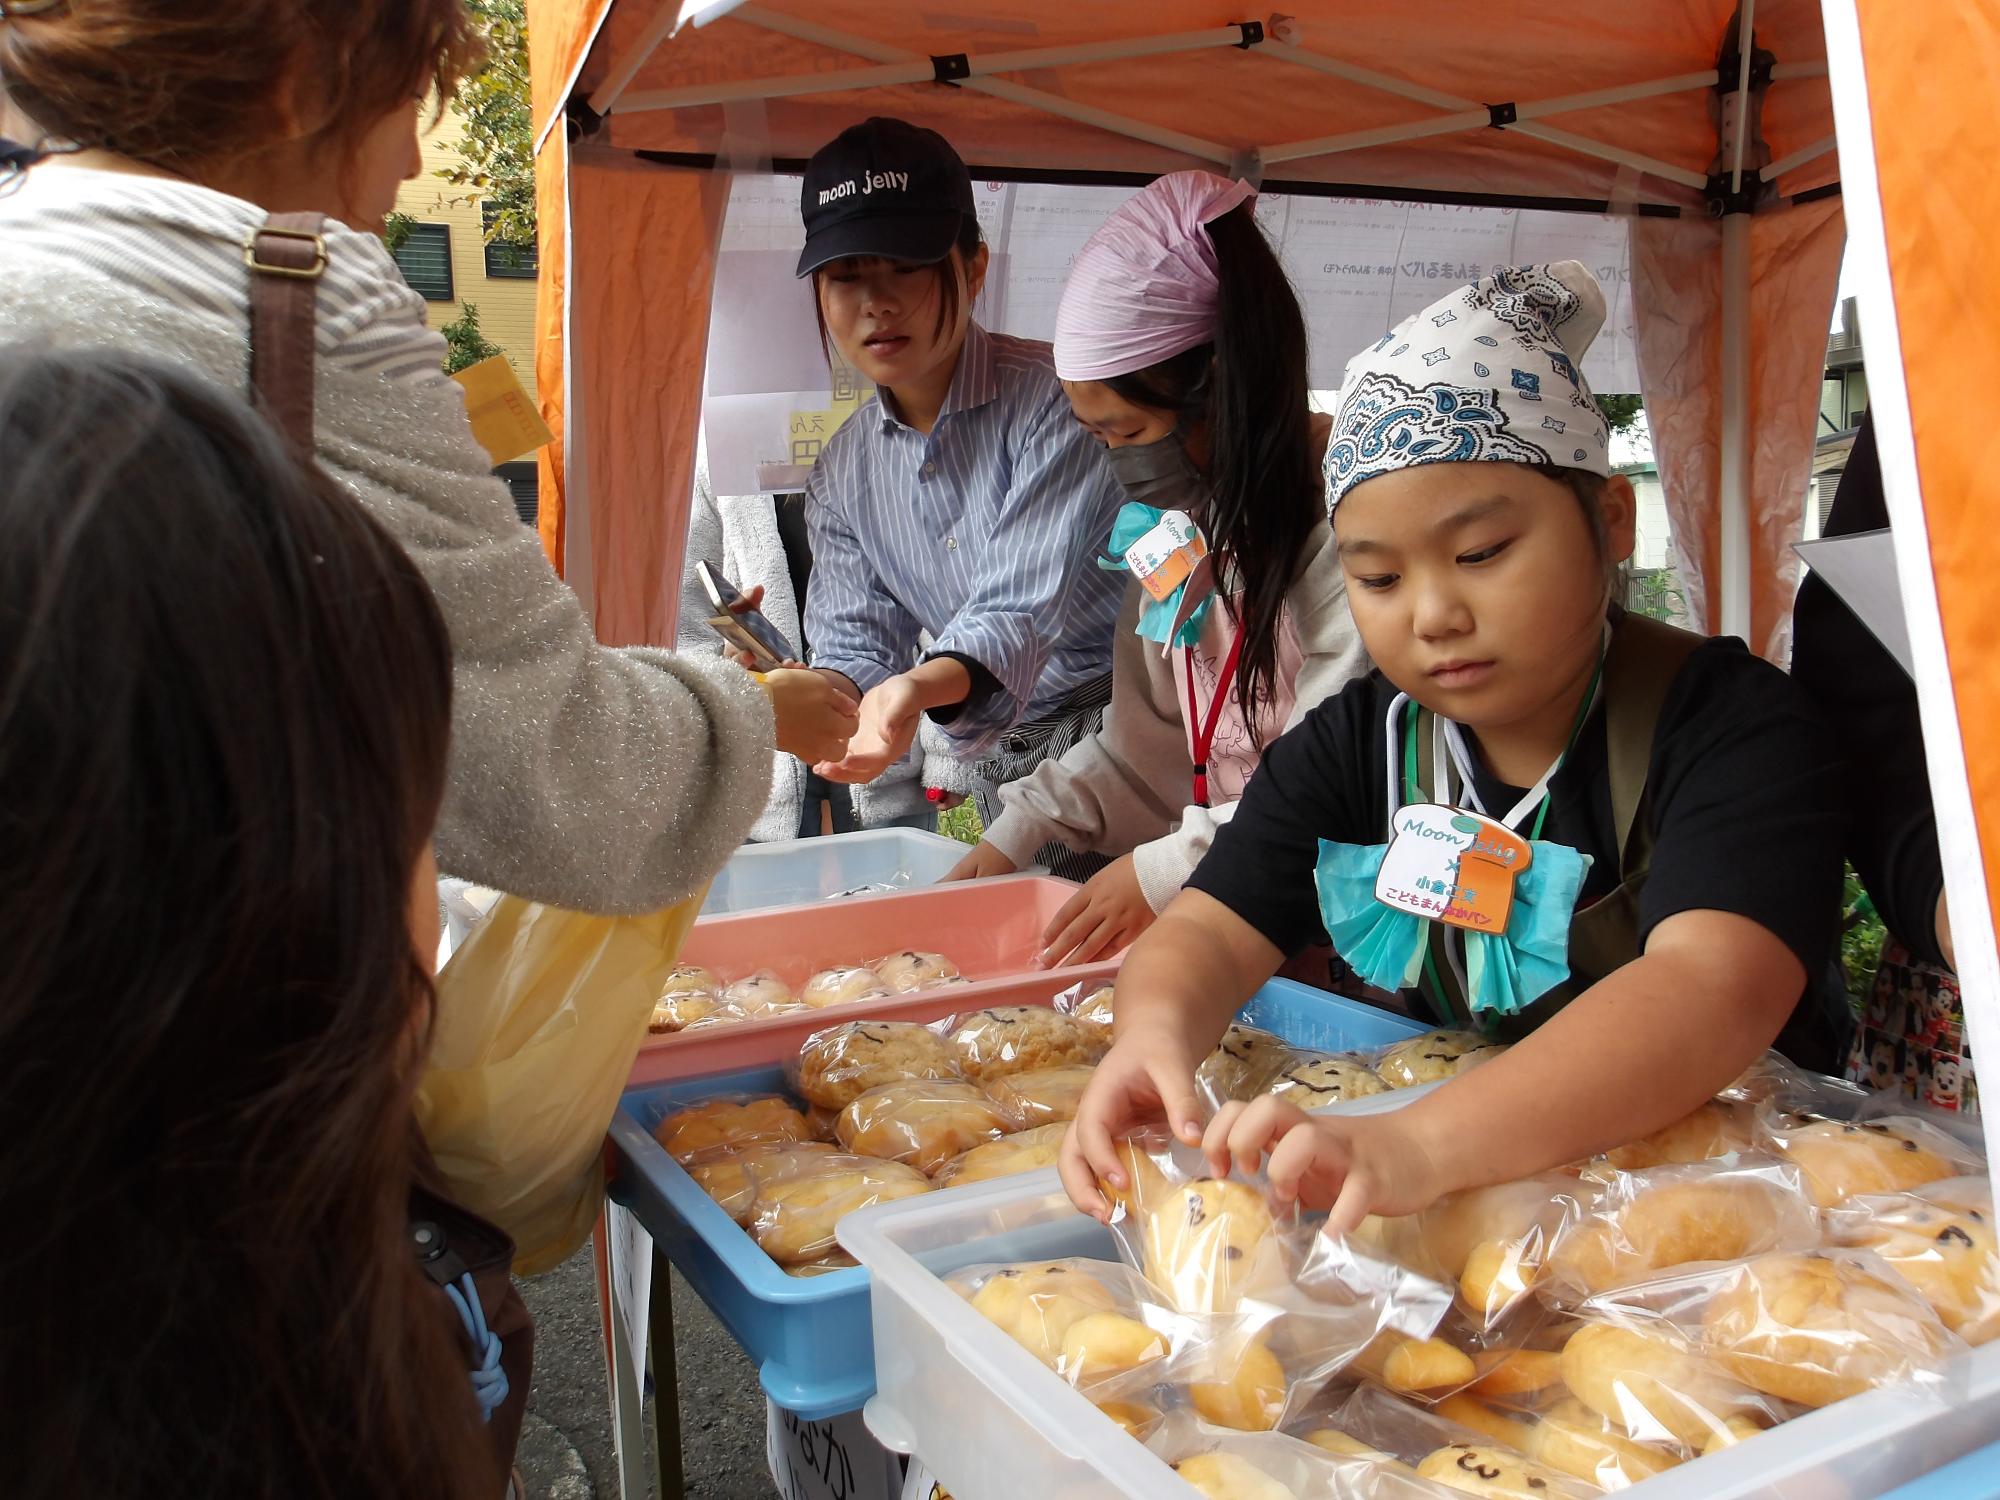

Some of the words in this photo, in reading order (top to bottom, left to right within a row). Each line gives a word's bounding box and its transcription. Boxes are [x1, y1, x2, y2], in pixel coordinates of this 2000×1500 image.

[818, 178, 857, 206] moon
[862, 169, 909, 195] jelly
[1163, 517, 1184, 543] Moon
[1402, 818, 1465, 846] Moon
